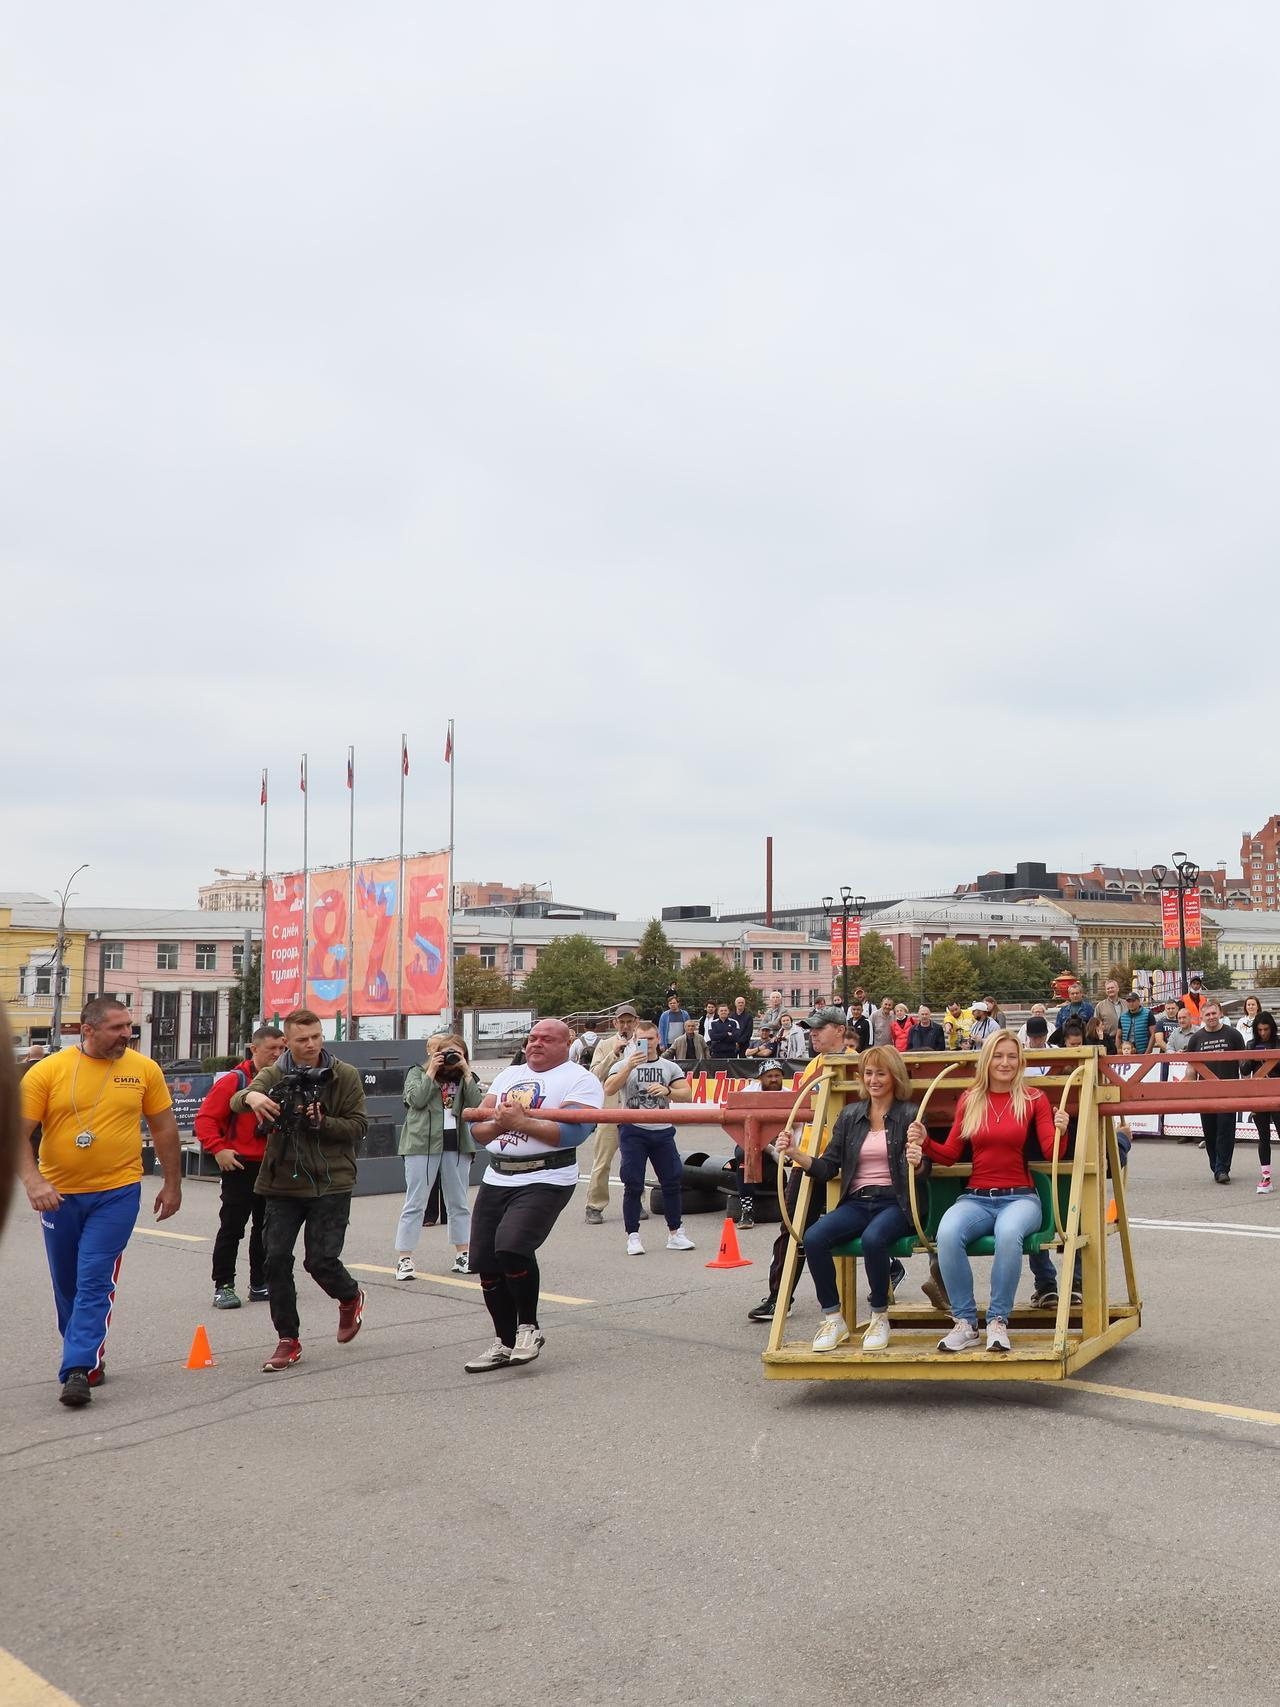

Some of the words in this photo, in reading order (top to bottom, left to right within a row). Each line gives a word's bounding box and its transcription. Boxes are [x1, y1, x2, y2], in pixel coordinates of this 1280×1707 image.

[272, 925, 279, 938] С
[271, 946, 300, 963] города,
[270, 965, 300, 985] туляки!
[365, 1074, 377, 1084] 200
